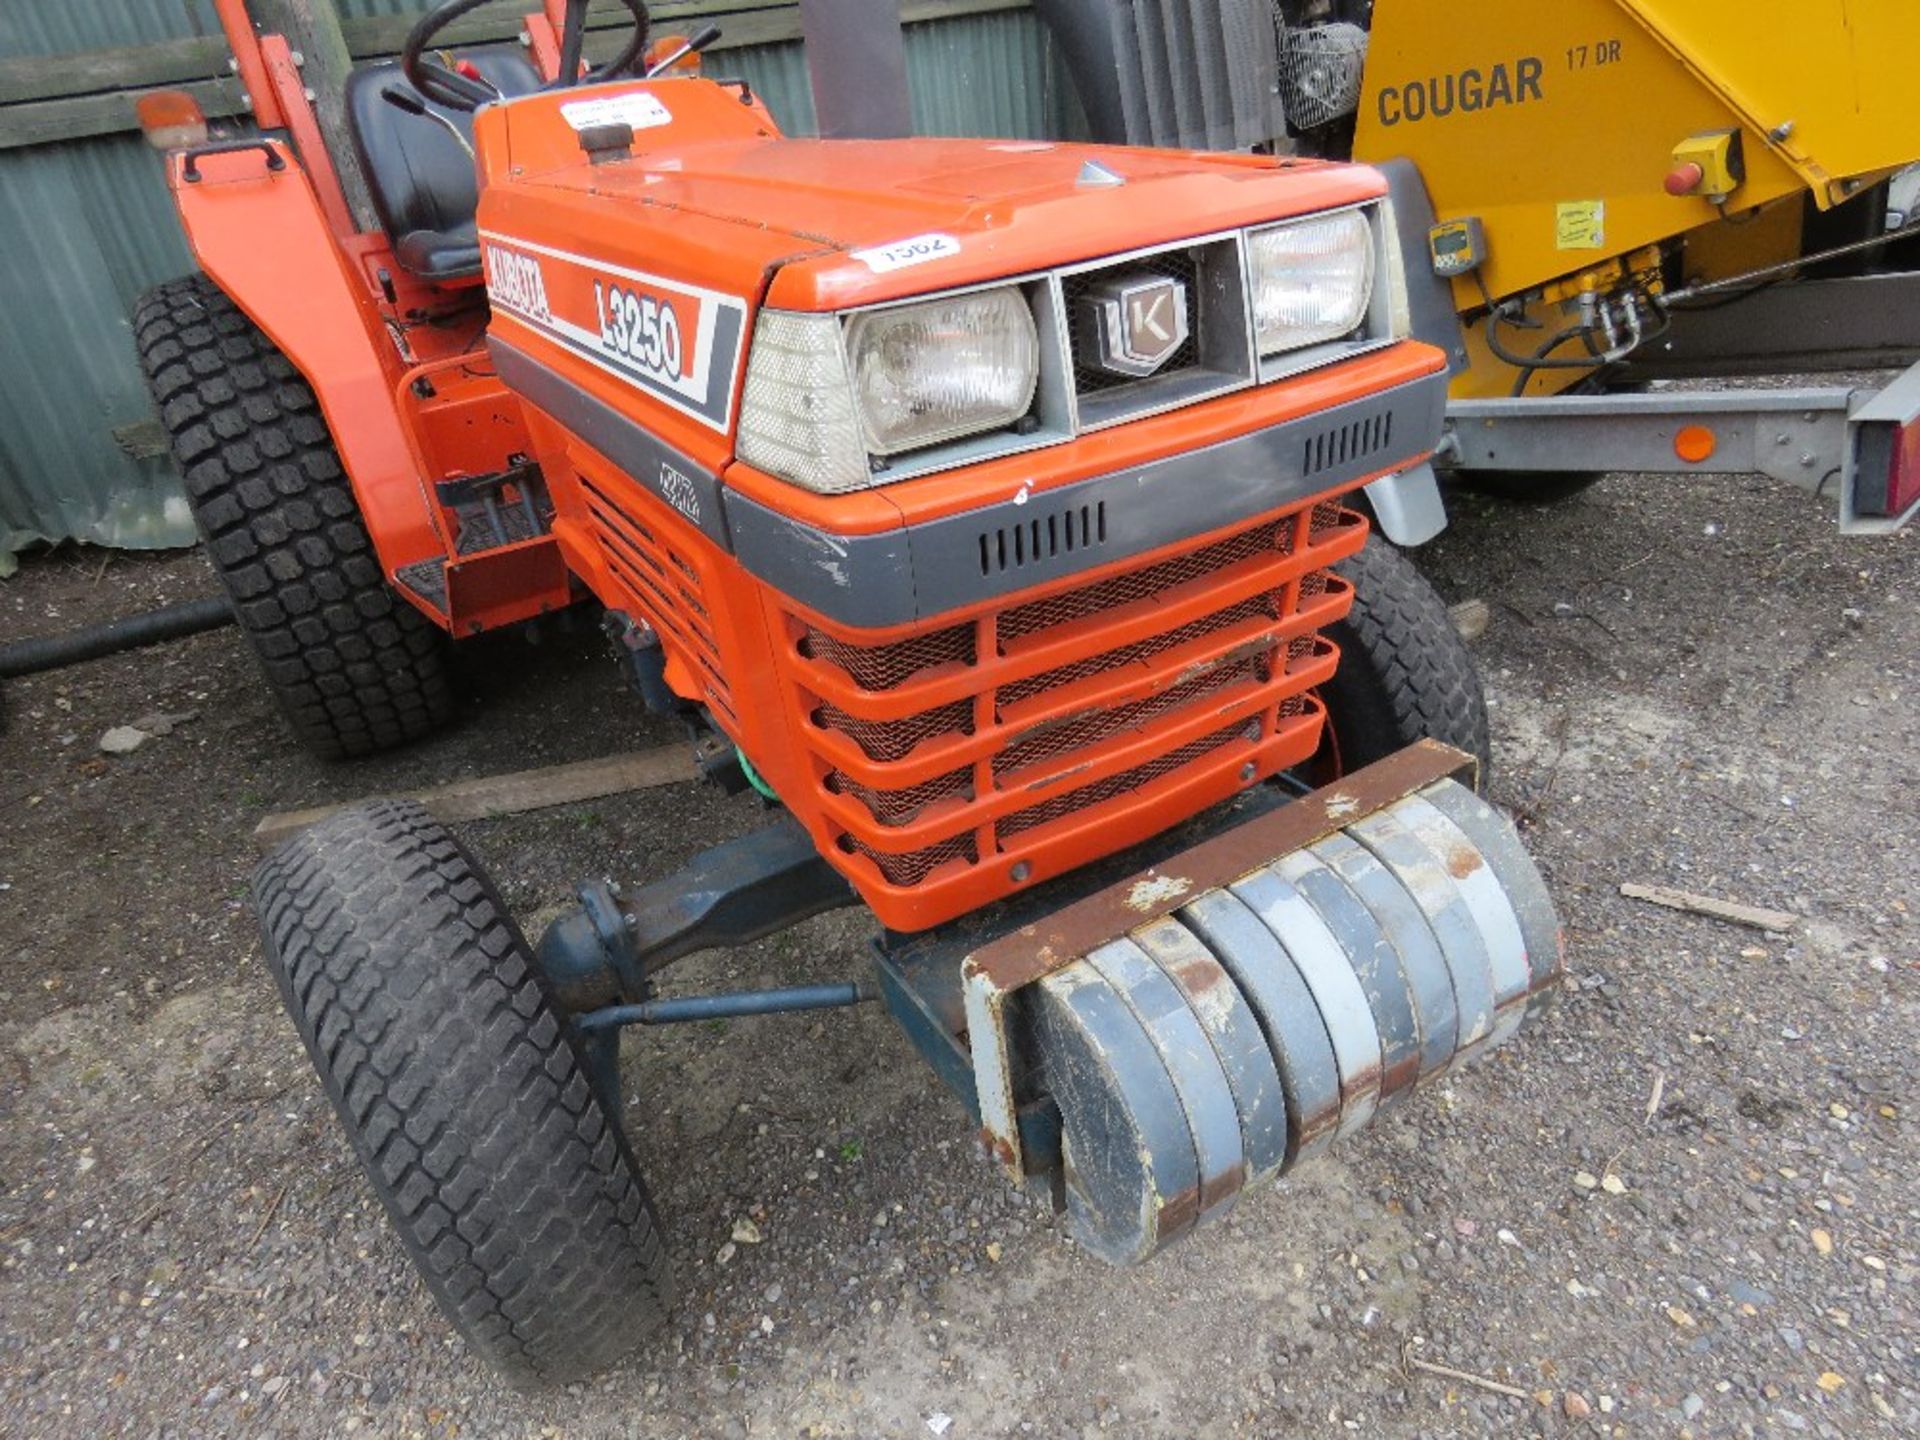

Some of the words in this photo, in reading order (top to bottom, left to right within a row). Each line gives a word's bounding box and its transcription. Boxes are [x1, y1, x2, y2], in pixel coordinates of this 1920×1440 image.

[1378, 57, 1543, 126] COUGAR
[1566, 46, 1588, 70] 17
[1596, 40, 1621, 65] DR
[487, 245, 553, 323] KUBOTA
[594, 279, 681, 382] L3250
[1133, 294, 1170, 340] K
